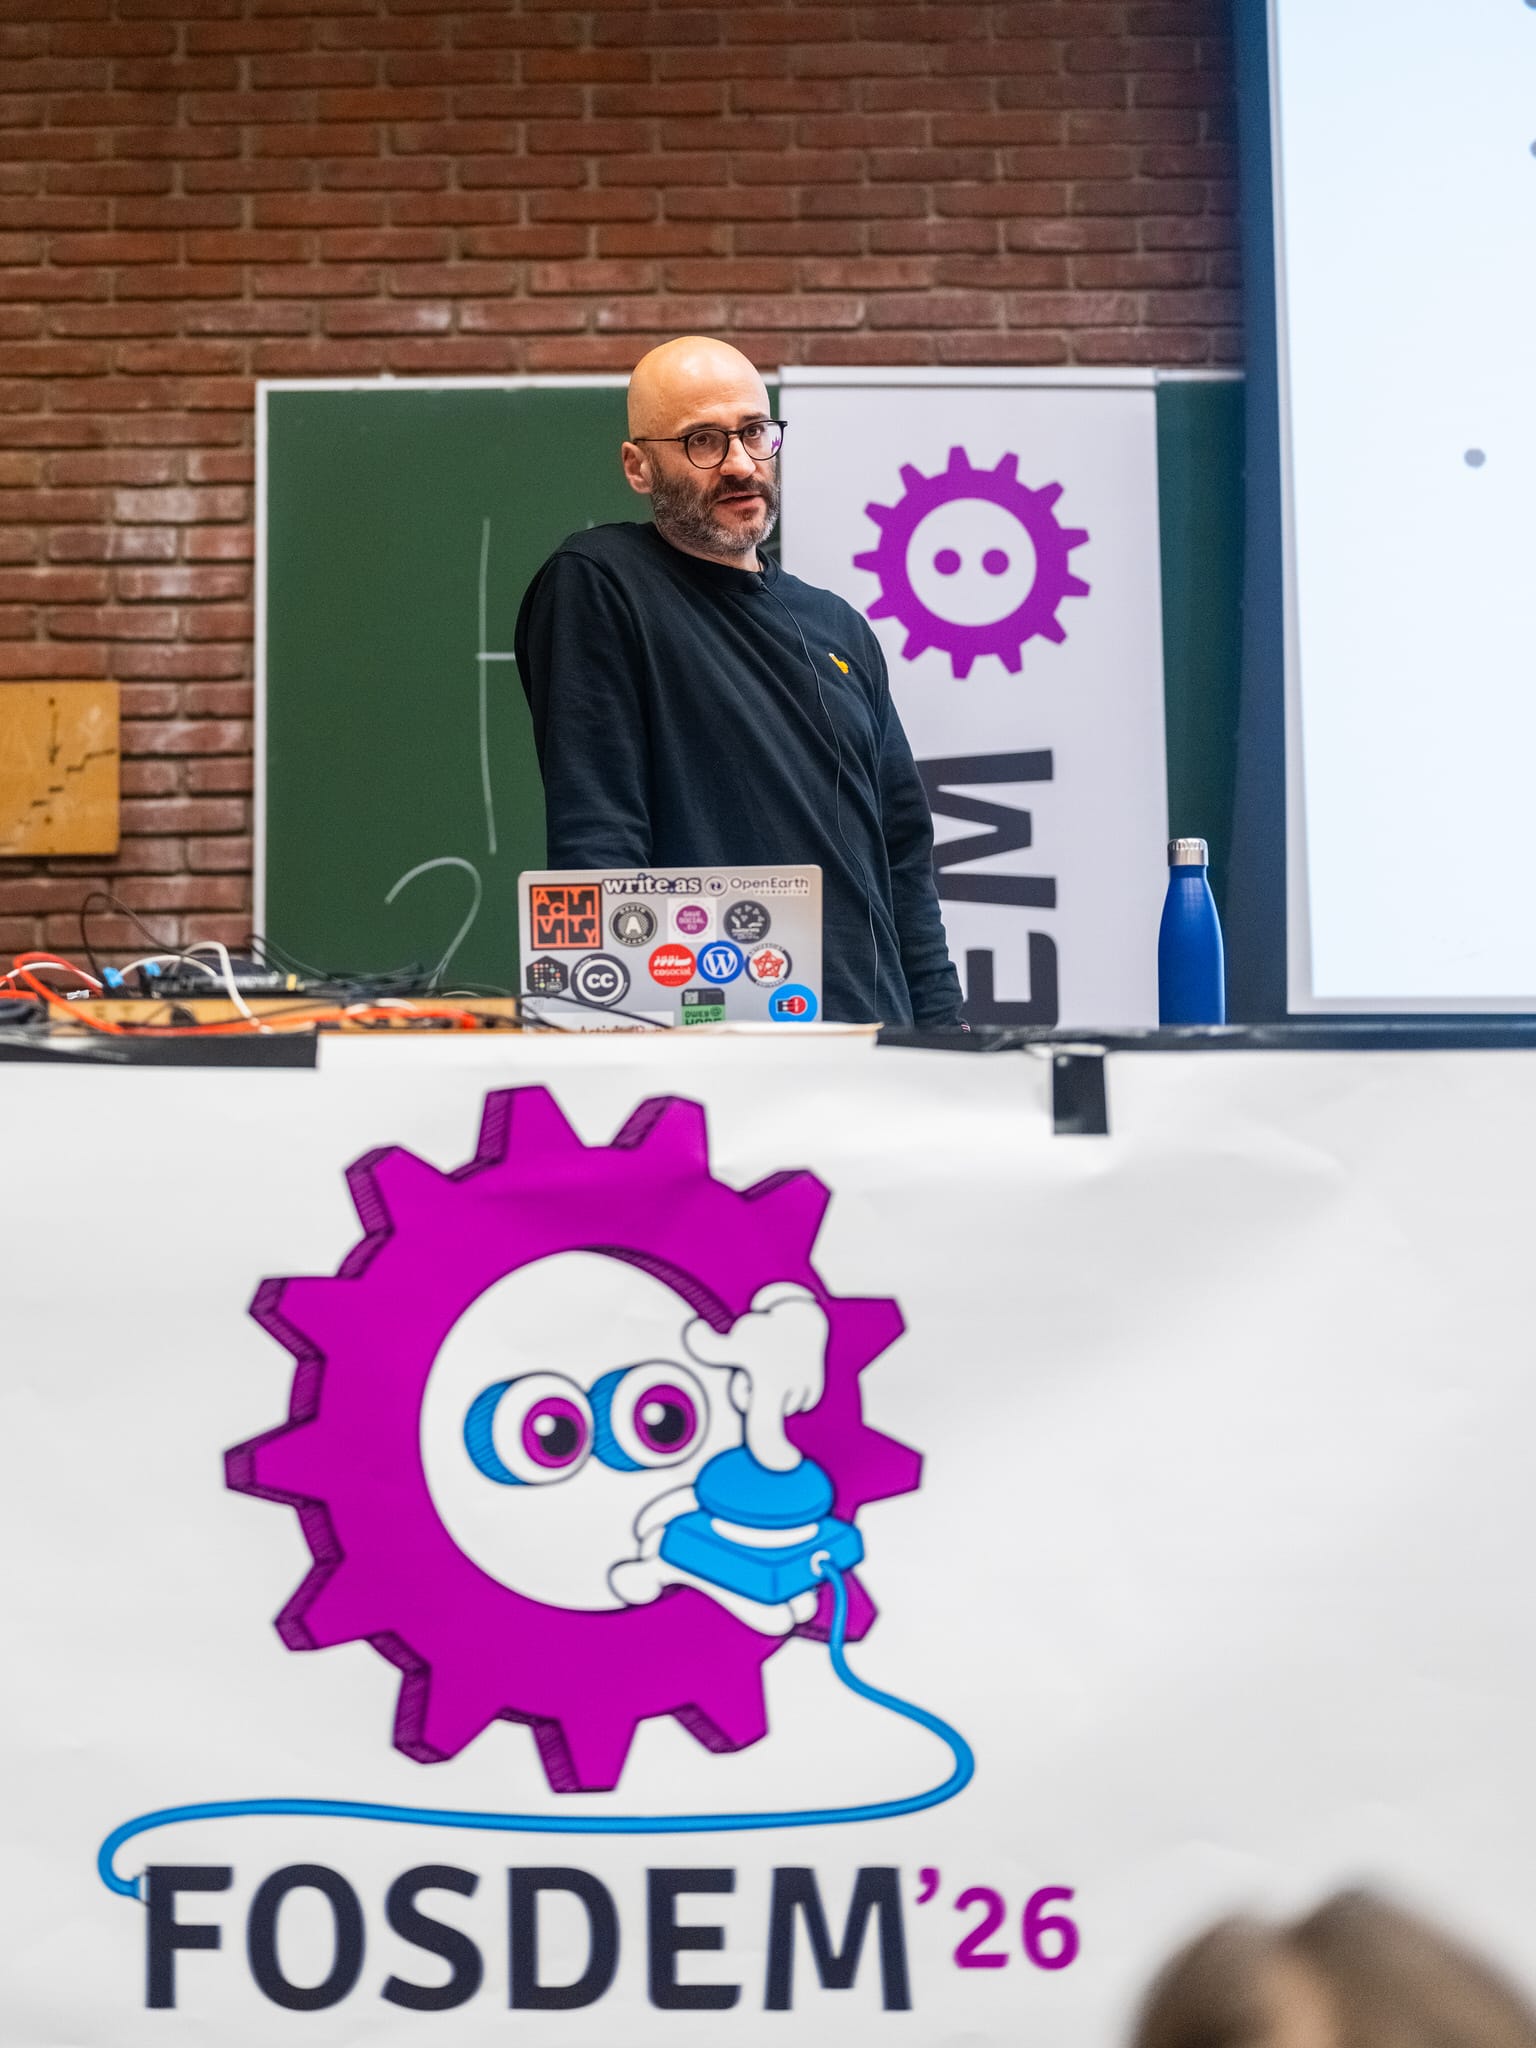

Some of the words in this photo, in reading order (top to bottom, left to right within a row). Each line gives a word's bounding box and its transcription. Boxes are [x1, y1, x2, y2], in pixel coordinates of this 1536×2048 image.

[602, 873, 700, 894] write.as
[731, 876, 809, 892] OpenEarth
[653, 965, 691, 976] cosocial
